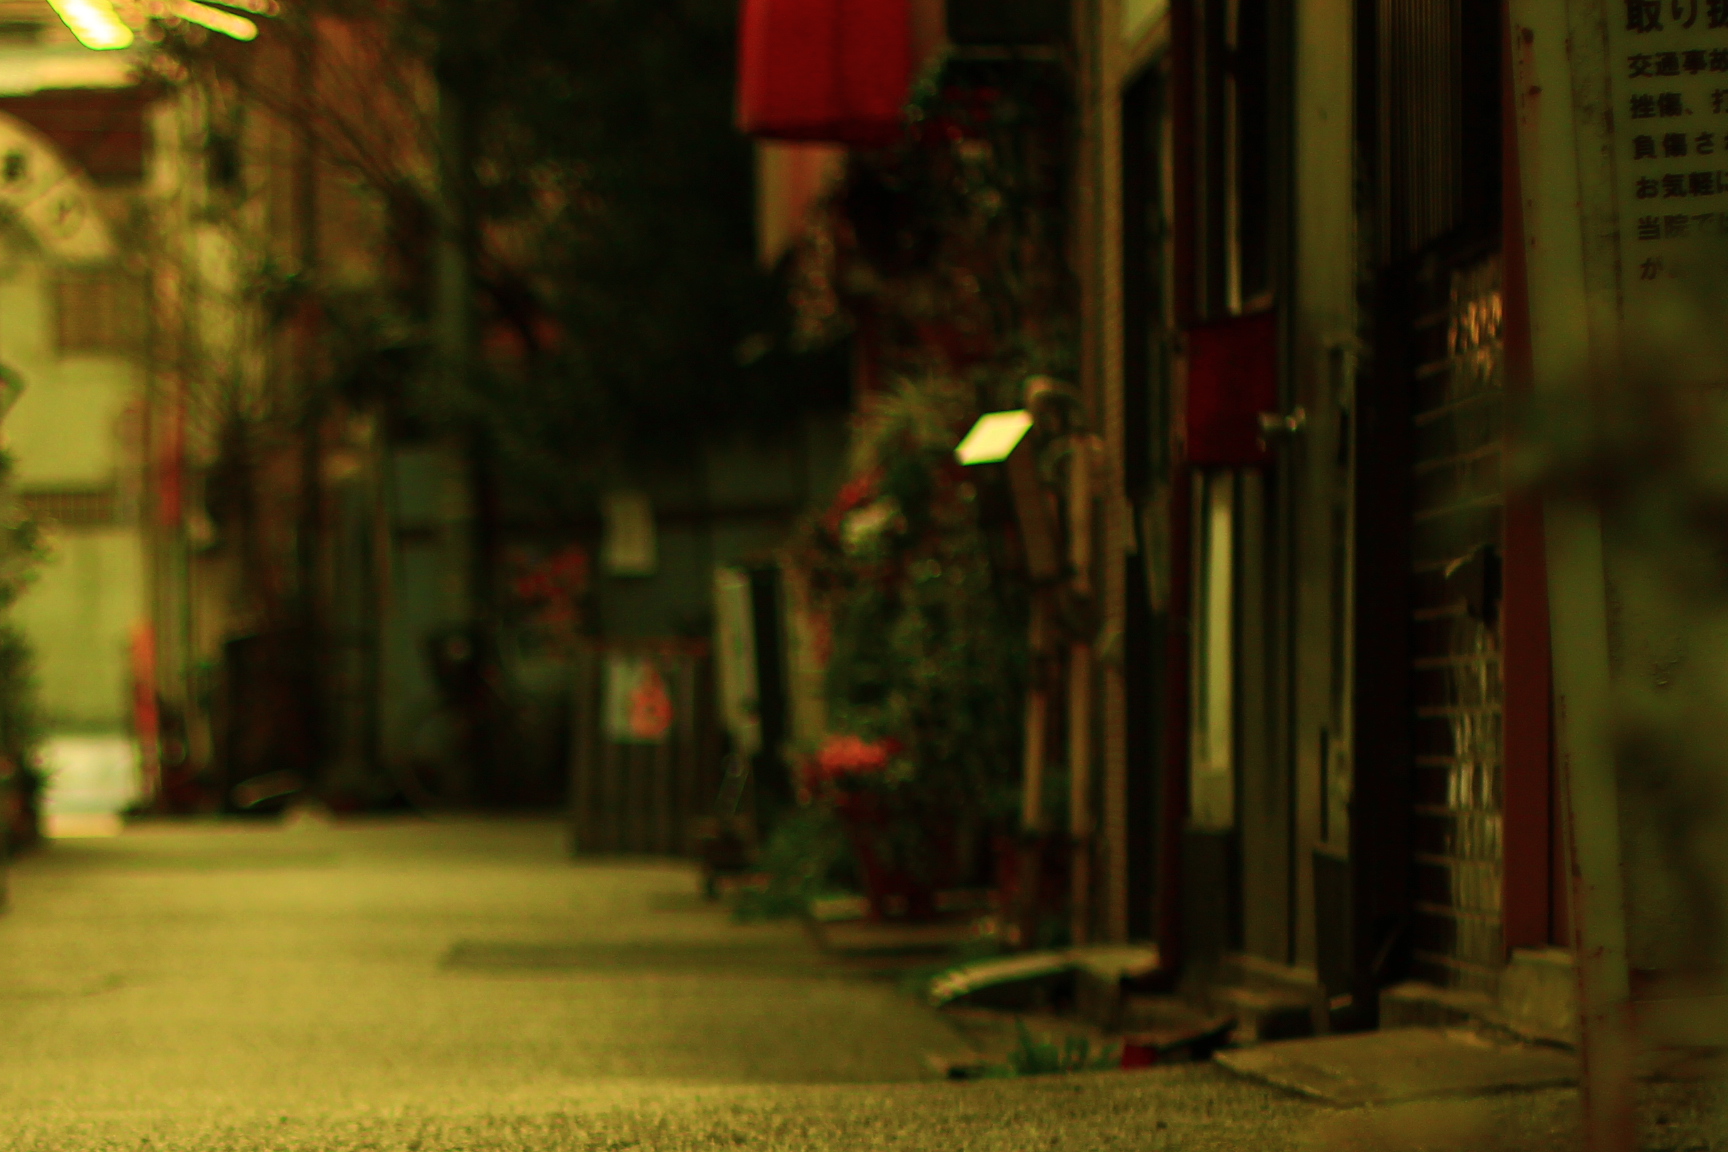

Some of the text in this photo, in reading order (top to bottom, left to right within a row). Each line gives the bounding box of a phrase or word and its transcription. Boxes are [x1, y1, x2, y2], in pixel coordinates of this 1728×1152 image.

[1627, 48, 1728, 79] 交通事故
[1633, 131, 1728, 160] 負傷さ
